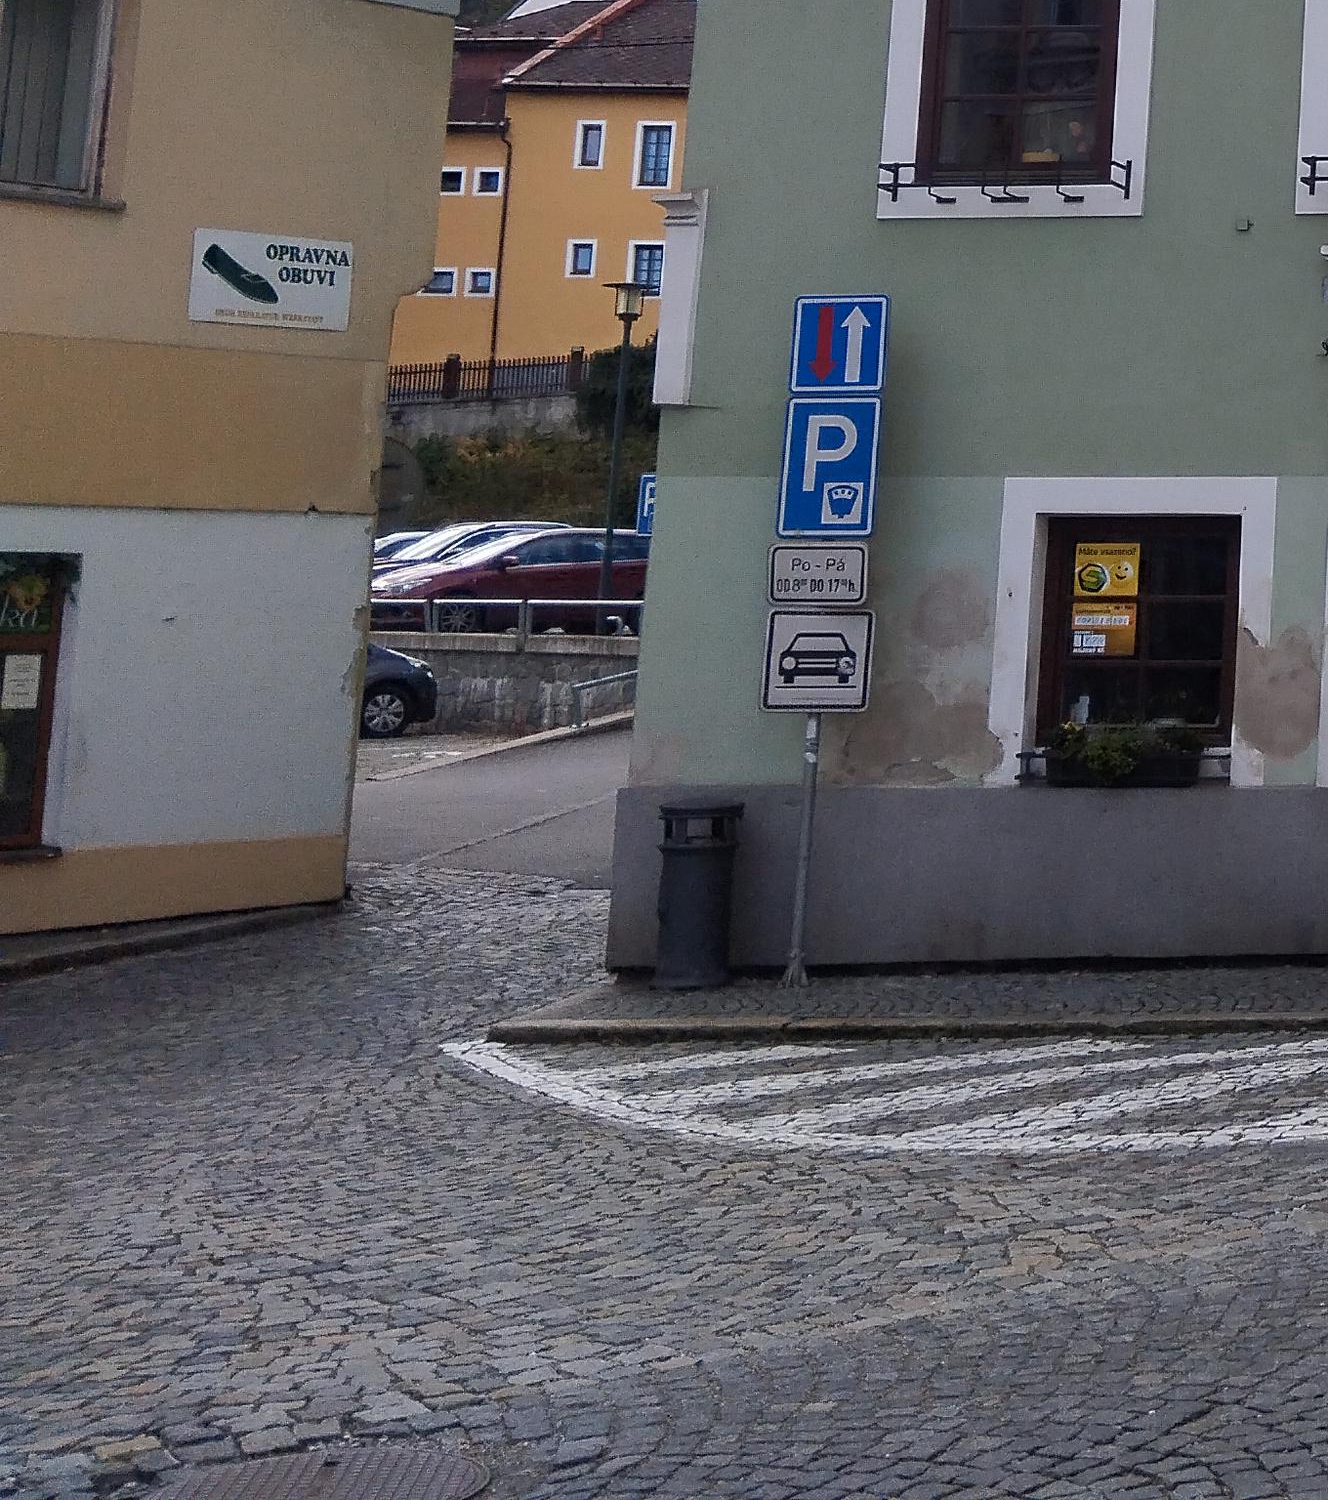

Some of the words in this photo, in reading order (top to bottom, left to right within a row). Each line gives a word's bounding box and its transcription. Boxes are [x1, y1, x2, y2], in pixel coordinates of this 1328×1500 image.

[265, 242, 351, 268] OPRAVNA
[278, 266, 336, 287] OBUVI
[802, 414, 858, 492] P
[791, 557, 811, 572] Po
[826, 557, 846, 572] Pá
[810, 578, 824, 592] DO
